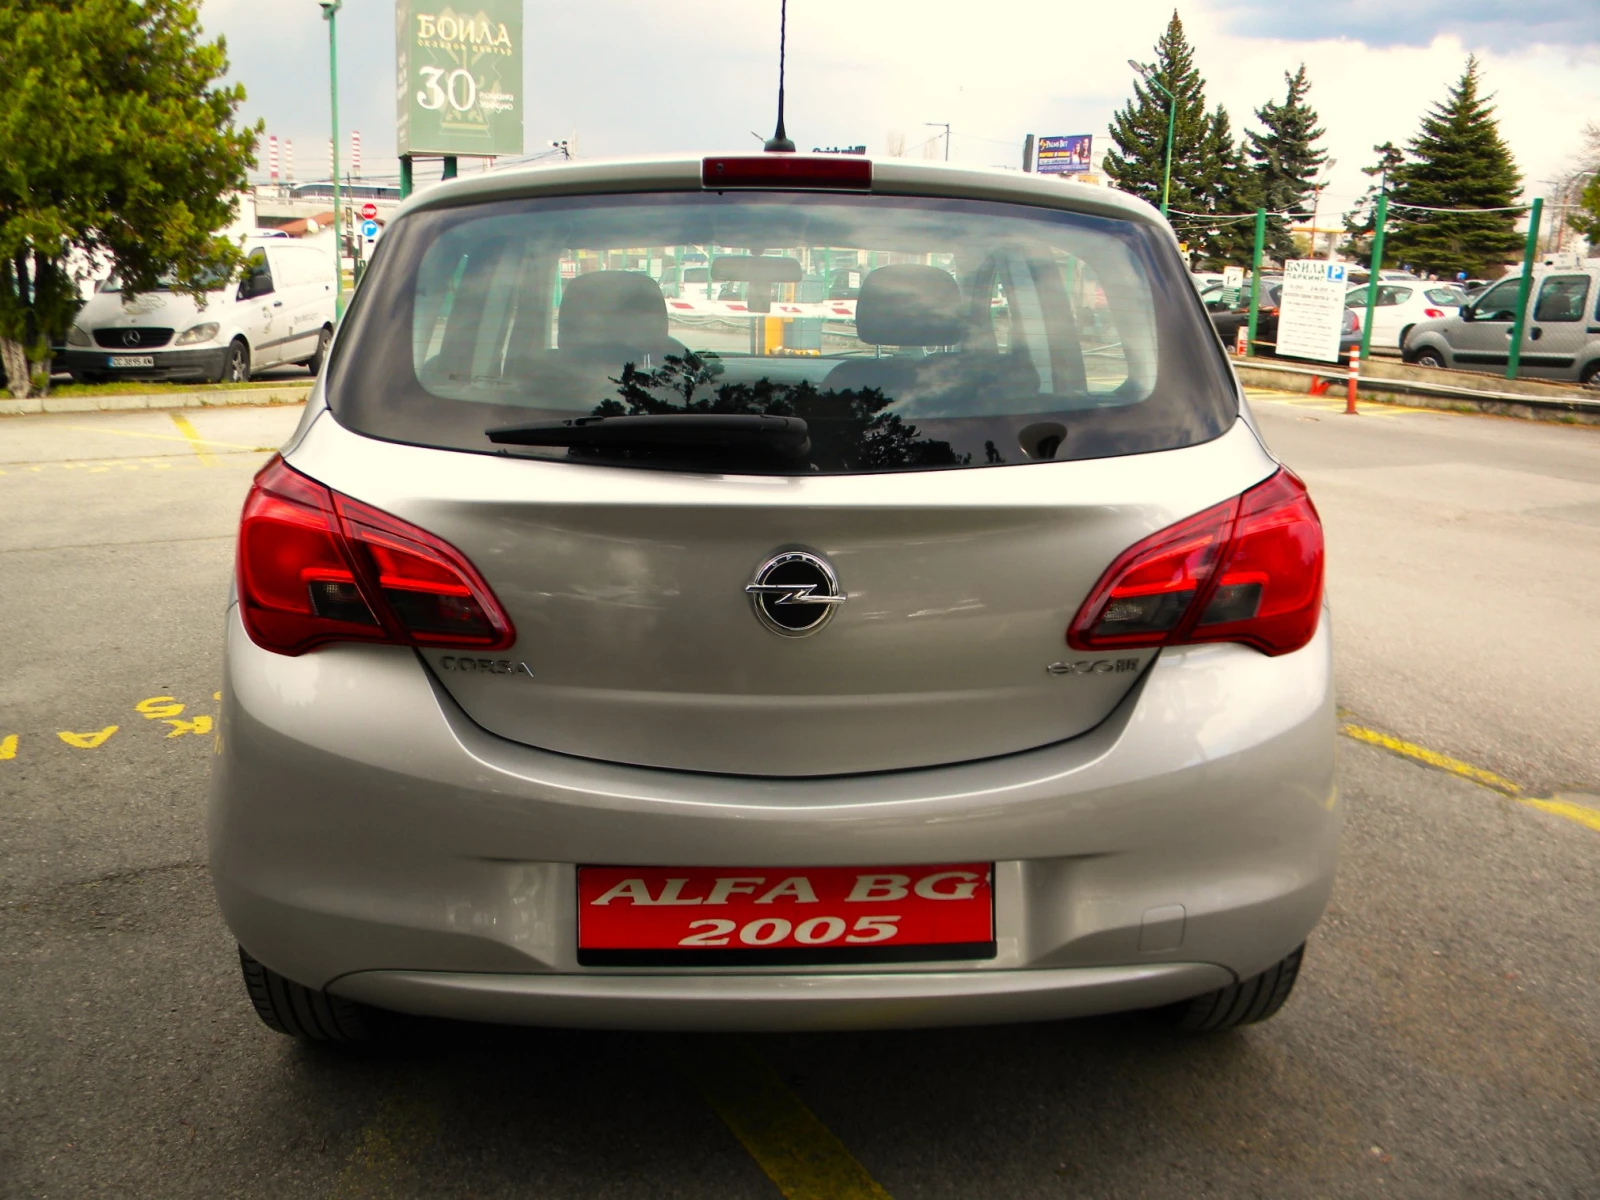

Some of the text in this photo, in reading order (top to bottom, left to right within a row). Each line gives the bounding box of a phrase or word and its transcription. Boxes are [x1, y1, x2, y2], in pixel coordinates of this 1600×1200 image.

[416, 66, 476, 111] 30
[771, 554, 820, 568] OPEL
[440, 656, 534, 677] CORSA
[590, 871, 980, 906] ALFA BG
[678, 916, 902, 946] 2005
